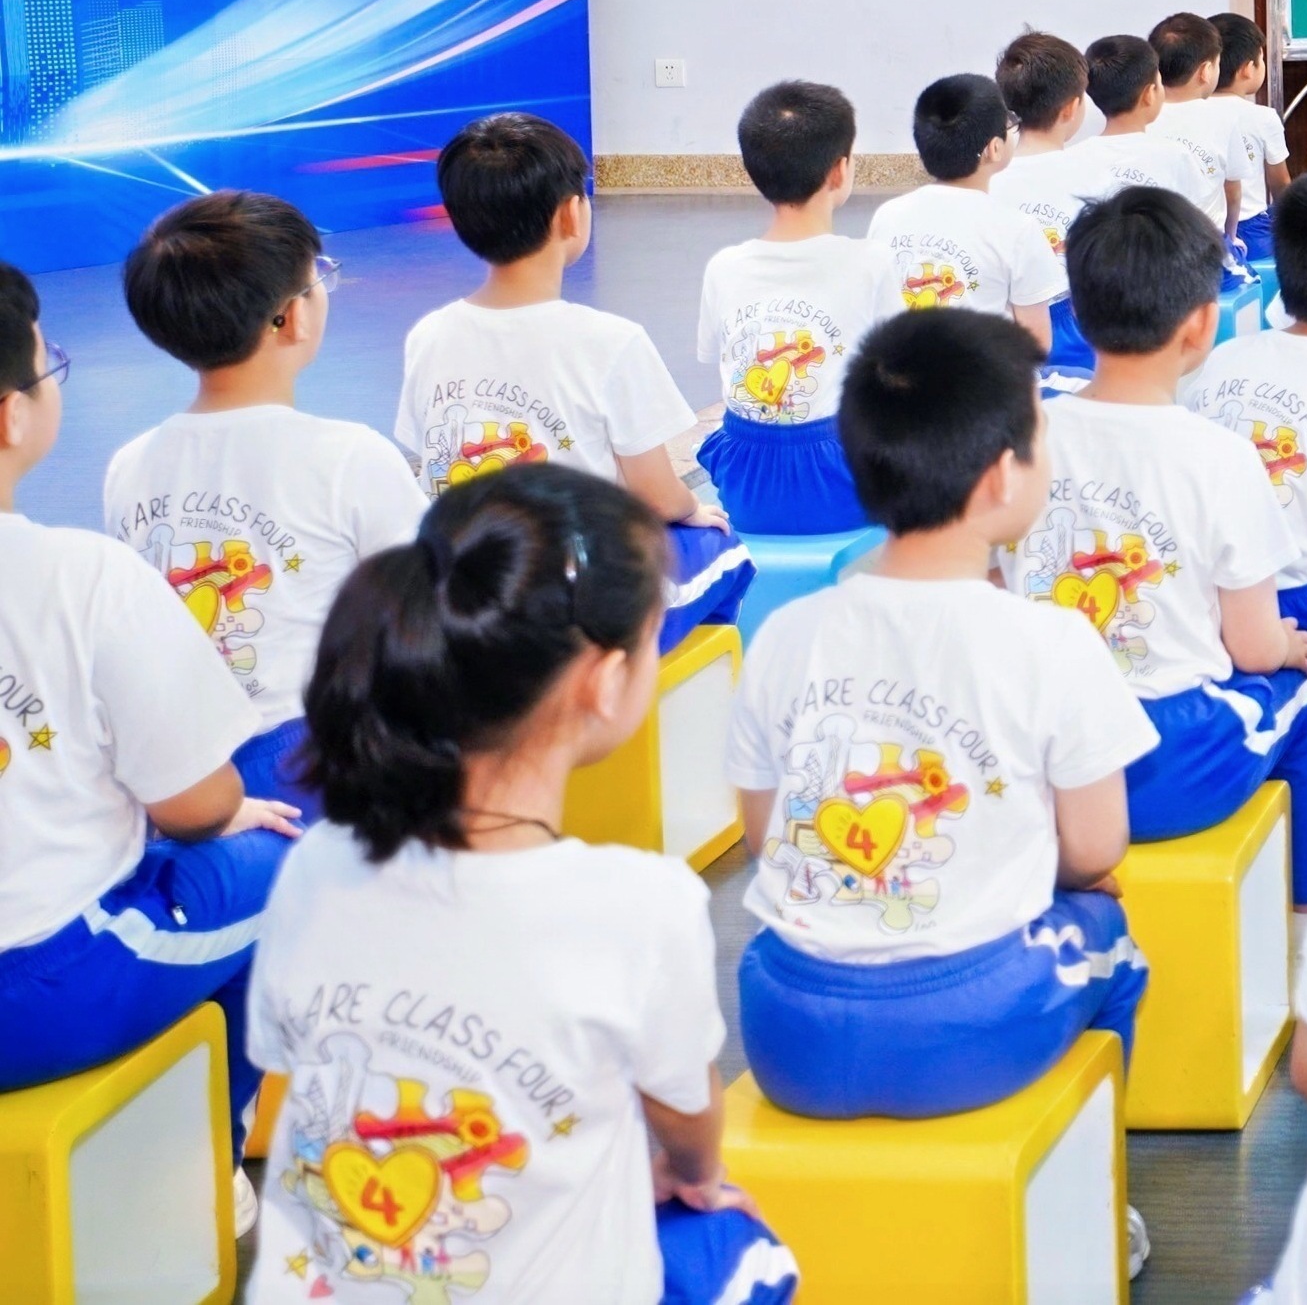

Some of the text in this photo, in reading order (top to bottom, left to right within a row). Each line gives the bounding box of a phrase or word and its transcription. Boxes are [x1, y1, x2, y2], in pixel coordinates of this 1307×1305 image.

[1194, 146, 1214, 165] FOUR
[891, 234, 979, 280] ARE CLASS FOUR
[735, 298, 842, 341] ARE CLASS FOUR
[760, 377, 776, 398] 4
[1215, 379, 1251, 401] ARE
[1254, 382, 1305, 417] CLASS
[432, 379, 467, 409] ARE
[474, 378, 529, 413] CLASS
[527, 401, 568, 439] FOUR
[471, 400, 524, 419] FRIENDSHIP
[1247, 398, 1294, 426] FRIENDSHIP
[133, 491, 298, 556] ARE CLASS FOUR
[179, 516, 242, 538] FRIENDSHIP
[1049, 478, 1178, 559] RE CLASS FOUR
[1079, 503, 1139, 531] FRIENDSHIP
[1076, 592, 1101, 624] 4
[0, 666, 44, 728] OUR
[801, 678, 998, 775] ARE CLASS FOUR
[863, 710, 935, 745] FRIENDSHIP
[845, 822, 878, 862] 4
[306, 982, 575, 1117] ARE CLASS FOUR
[359, 1176, 404, 1227] 4
